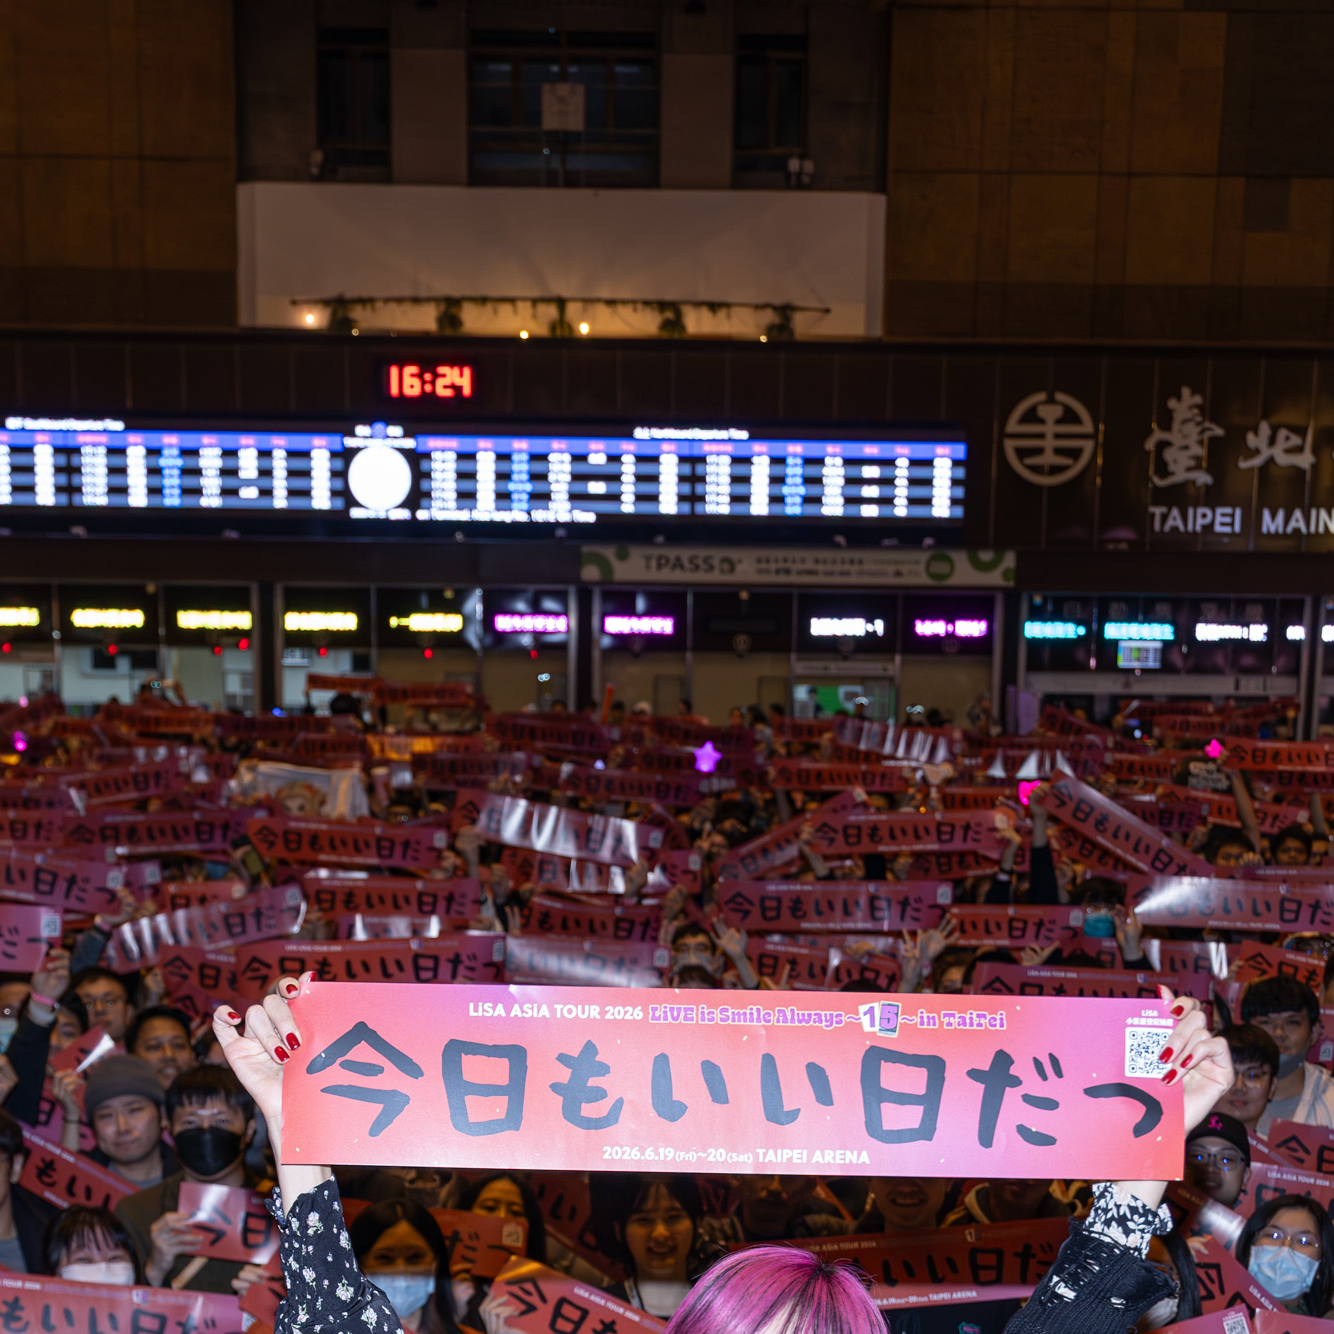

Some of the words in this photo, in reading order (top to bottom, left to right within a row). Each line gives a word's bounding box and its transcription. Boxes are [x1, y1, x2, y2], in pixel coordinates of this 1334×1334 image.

[389, 365, 473, 398] 16:24
[1148, 505, 1243, 534] TAIPEI
[643, 554, 714, 575] TPASS
[724, 890, 947, 923] 今日もいい日だっ
[469, 1001, 507, 1018] LiSA
[510, 1002, 550, 1018] ASiA
[553, 1003, 600, 1020] TOUR
[604, 1004, 644, 1021] 2026
[648, 1004, 696, 1025] LiVE
[698, 1005, 717, 1025] is
[717, 1005, 773, 1026] Smile
[1141, 1009, 1159, 1018] LiSA
[305, 1020, 1162, 1150] 今日もいい日だっ
[602, 1146, 753, 1164] 2026.6.19(Fri)~20(Sat)
[756, 1148, 808, 1165] TAIPEI
[811, 1149, 871, 1166] ARENA
